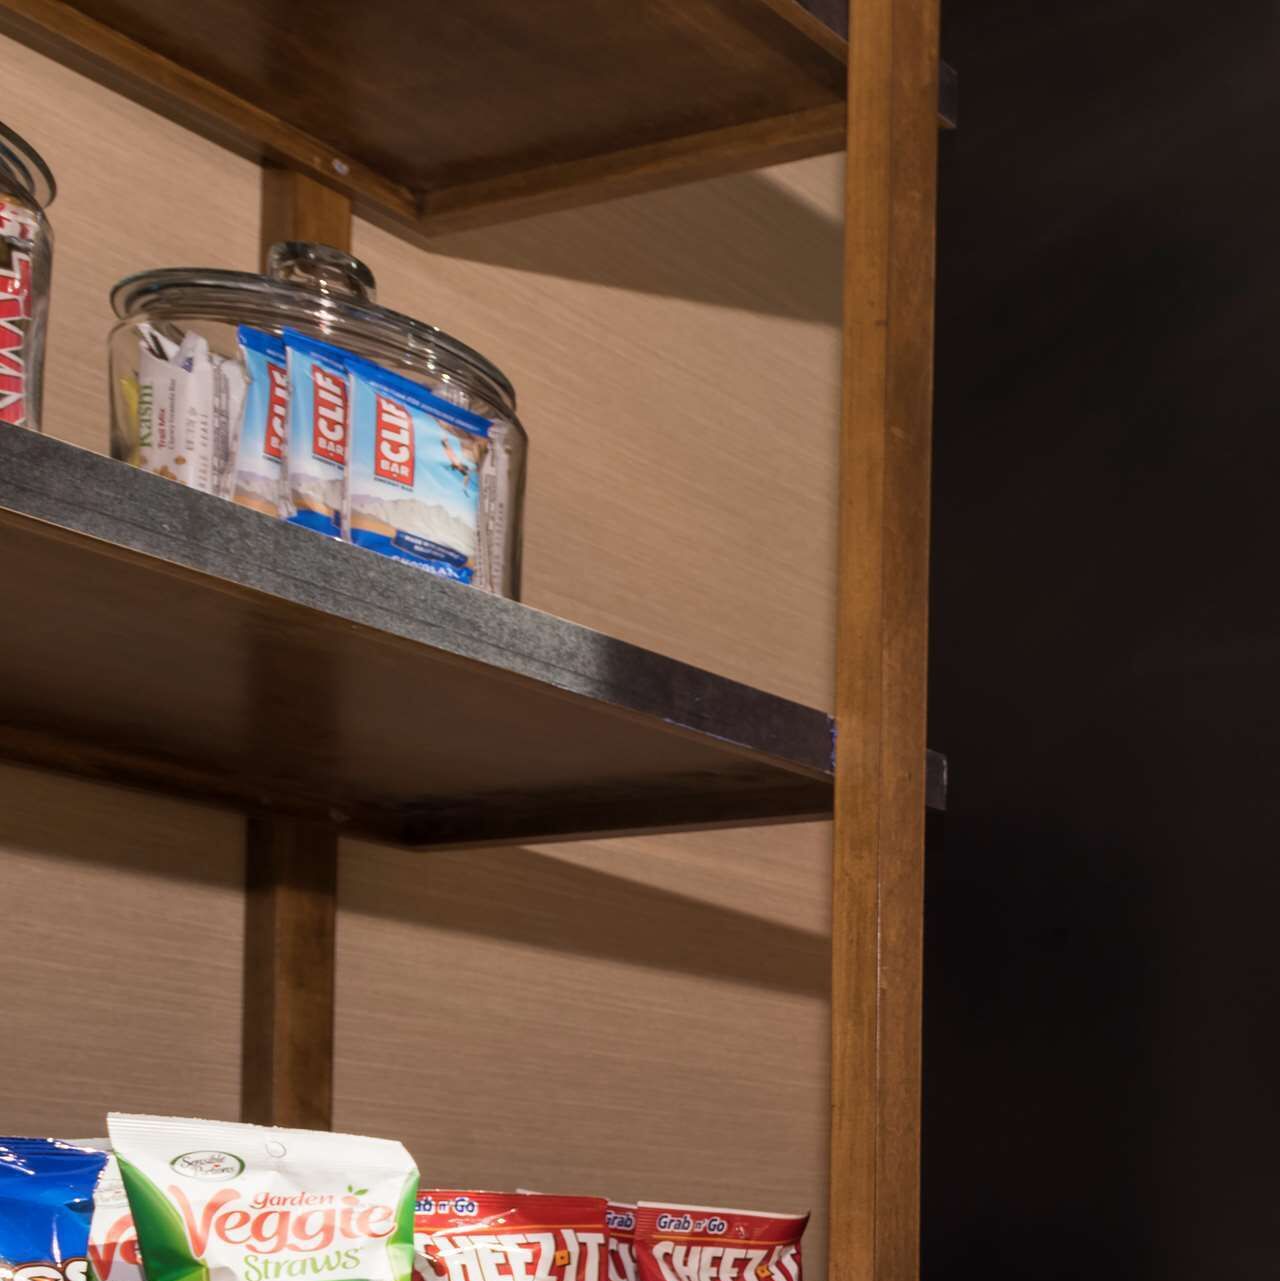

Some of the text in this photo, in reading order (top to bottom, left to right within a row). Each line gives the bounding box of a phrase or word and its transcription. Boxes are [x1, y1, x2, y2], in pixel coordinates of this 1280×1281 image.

[315, 371, 344, 441] CLIF
[380, 397, 410, 463] CLIF
[380, 459, 409, 478] BAR
[249, 1192, 334, 1209] garden
[414, 1197, 433, 1214] ab
[453, 1197, 477, 1215] Go
[168, 1184, 397, 1258] Veggie
[657, 1214, 691, 1232] Grab
[706, 1217, 727, 1233] Go
